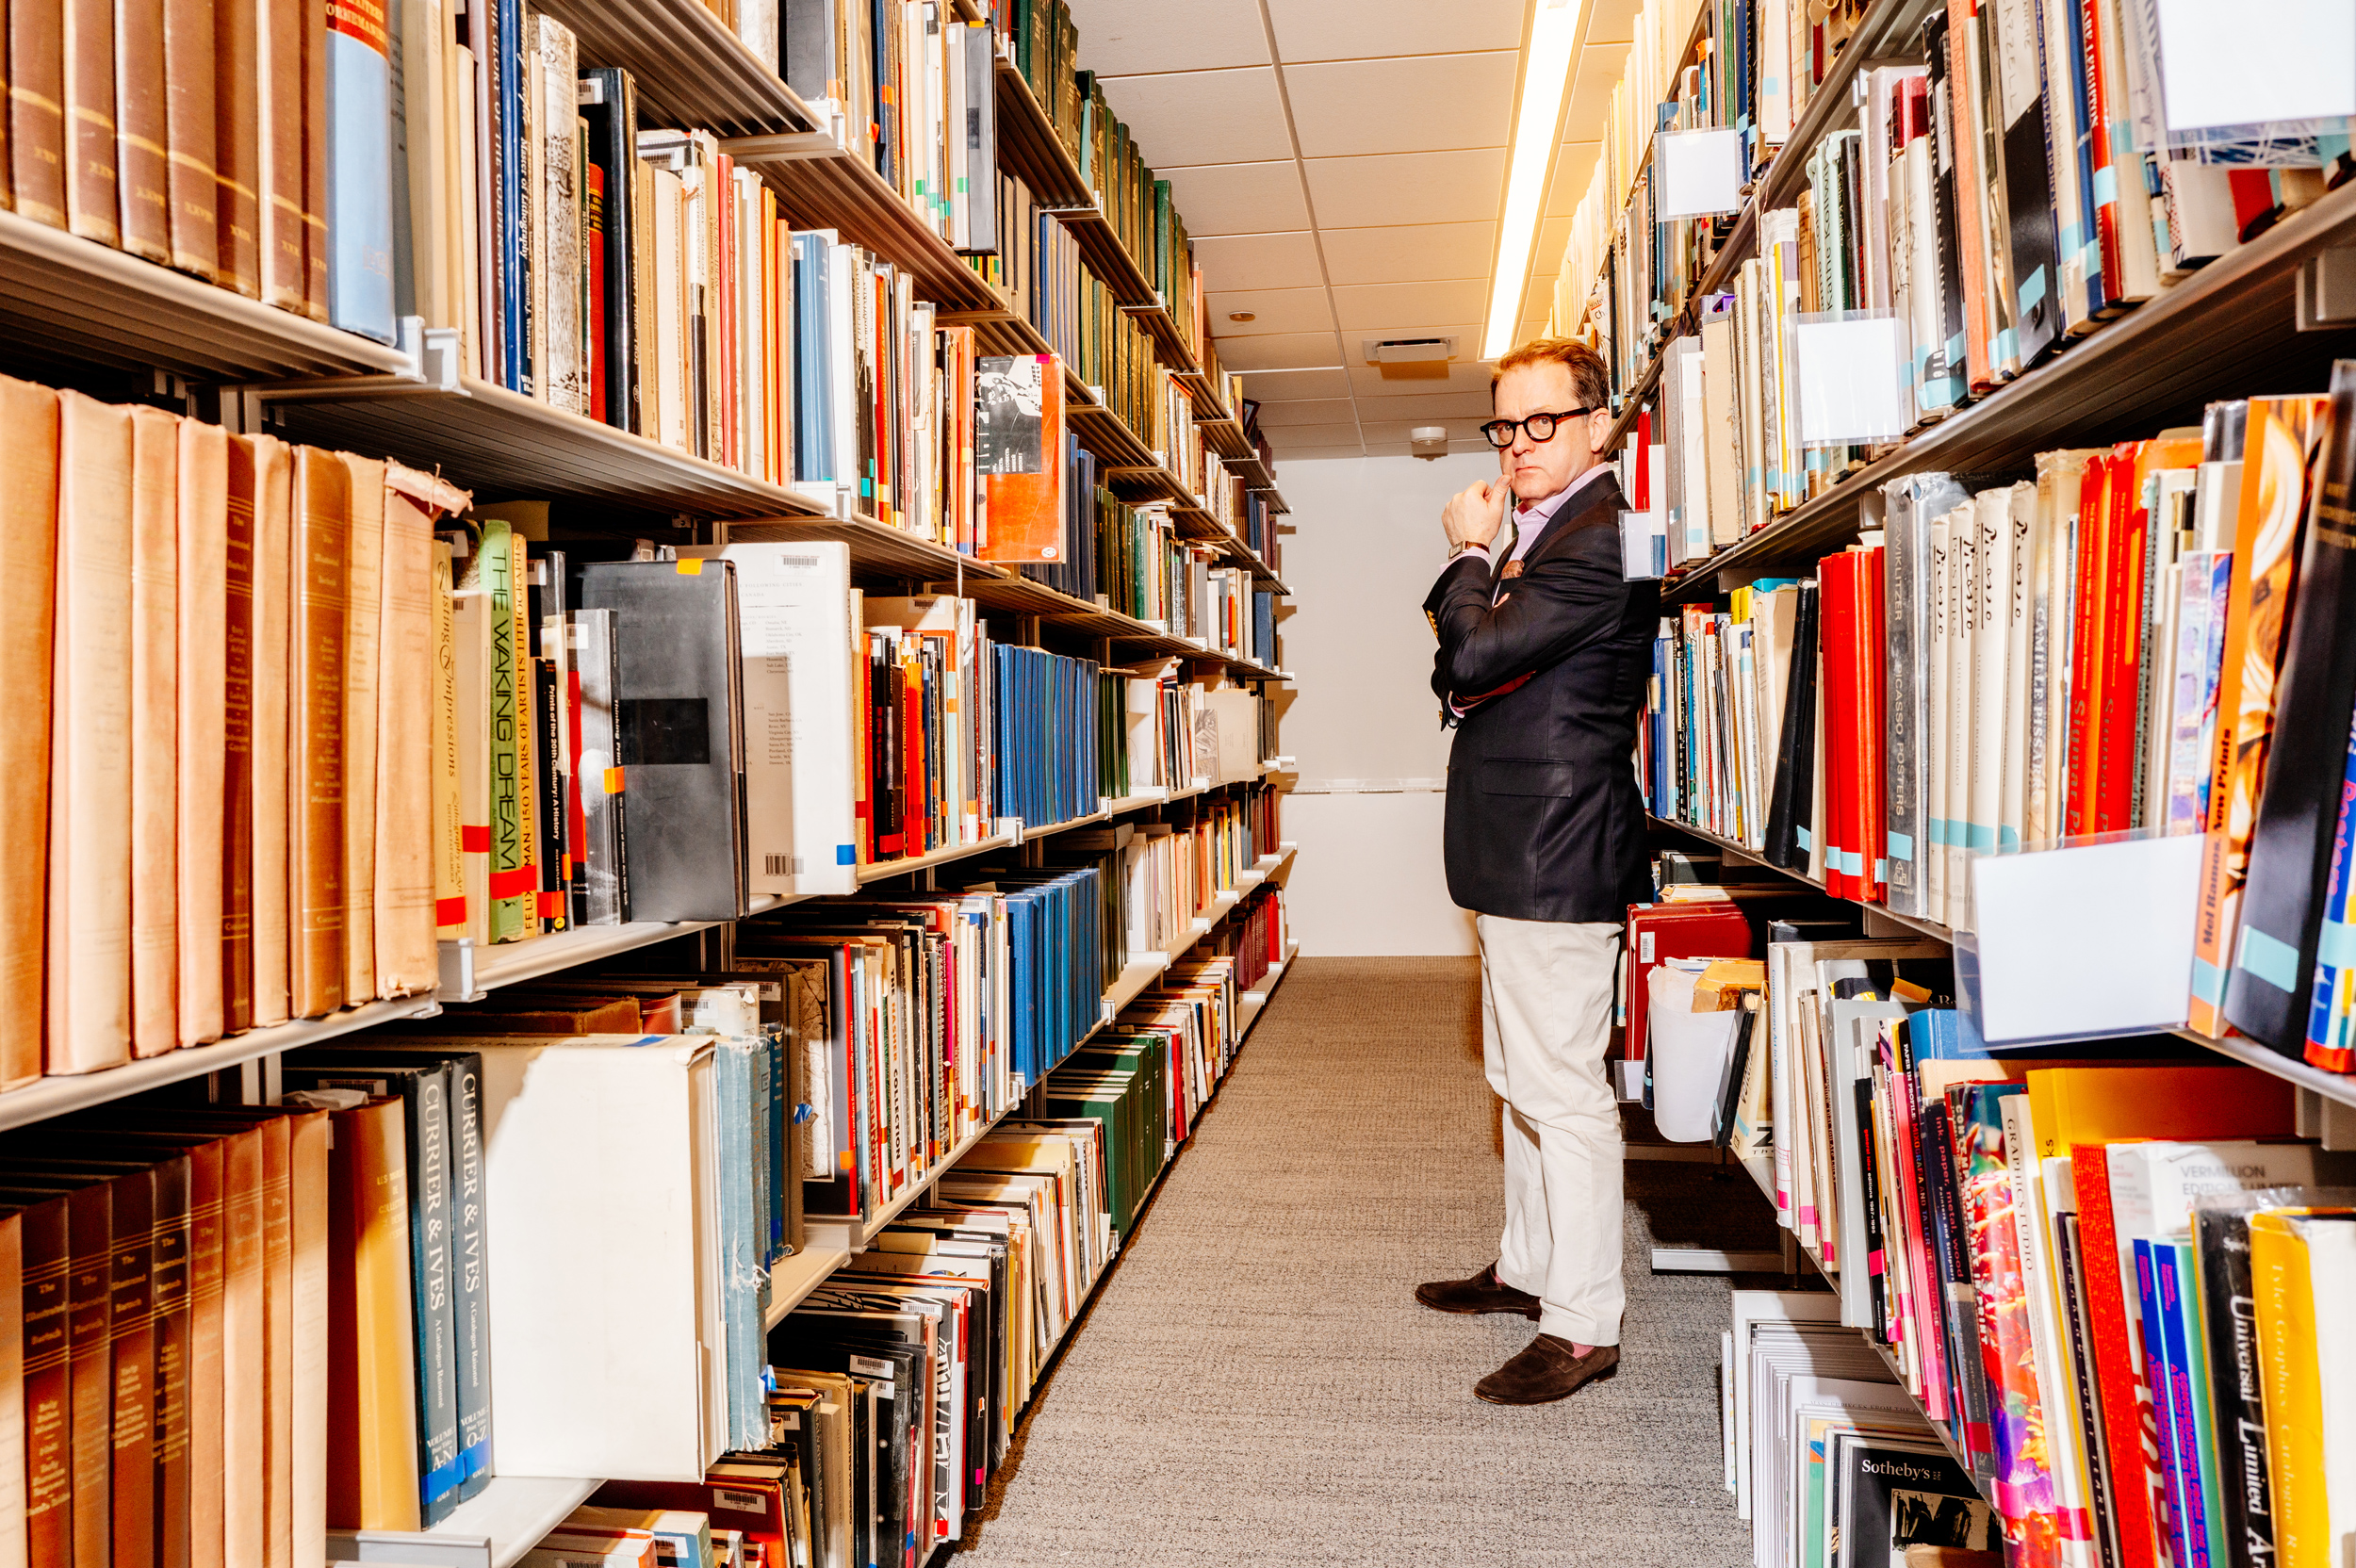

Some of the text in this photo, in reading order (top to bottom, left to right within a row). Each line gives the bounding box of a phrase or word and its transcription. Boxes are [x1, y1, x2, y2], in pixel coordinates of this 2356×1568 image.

[492, 34, 501, 92] GLORY
[1953, 35, 1964, 125] LARSSON
[2085, 44, 2099, 129] LEIGHTON
[494, 102, 503, 125] OF
[496, 132, 504, 168] THE
[2041, 88, 2057, 211] BLANCHE LAZZELL
[519, 137, 531, 259] Master of Lithography
[523, 270, 532, 304] Kenneth
[1936, 548, 1947, 634] Picasso
[1984, 527, 1998, 621] Picasso
[2016, 519, 2028, 618] Picasso
[514, 542, 526, 650] LITHOGRAPHS
[437, 562, 456, 777] Lasting Impressions
[517, 653, 528, 716] ARTISTS'
[492, 548, 516, 871] THE WAKING DREAM
[550, 711, 556, 722] of
[1895, 663, 1904, 735] PICASSO
[2032, 606, 2045, 807] CAMILLE PISSARRO
[519, 720, 529, 740] OF
[2069, 698, 2086, 802] Sigmar
[520, 743, 530, 792] YEARS
[1896, 742, 1905, 816] POSTERS
[522, 832, 532, 866] MAN
[2201, 728, 2231, 945] Mel Ramos. New Prints
[1774, 1049, 1778, 1057] in
[1904, 1043, 1912, 1070] PAPER
[1906, 1070, 1913, 1082] IN
[1907, 1083, 1917, 1121] PROFILE:
[1935, 1116, 1945, 1141] ink,
[1864, 1128, 1873, 1156] general
[1911, 1122, 1924, 1184] MIXOGRAFIA
[1938, 1145, 1950, 1187] paper,
[1955, 1103, 1977, 1232] CONTEMPORARY
[424, 1083, 446, 1312] CURRIER & IVES
[461, 1072, 480, 1293] CURRIER & IVES
[2180, 1165, 2266, 1178] VERMILLION
[1939, 1186, 1947, 1220] Painters
[1946, 1241, 1955, 1282] Sculptors
[1946, 1191, 1957, 1233] metal,
[1926, 1248, 1934, 1263] DE
[1952, 1238, 1965, 1278] wood
[1972, 1235, 1980, 1267] ART
[1974, 1273, 1983, 1290] IN
[2268, 1265, 2285, 1311] Tyler
[469, 1300, 480, 1388] A Catalogue Raisonné
[1977, 1296, 1988, 1346] PRINT
[434, 1319, 445, 1410] A Catalogue Raisonné
[461, 1408, 486, 1428] VOLUME
[2156, 1360, 2176, 1463] CONVERSATIONS
[2172, 1375, 2184, 1414] Master
[2230, 1295, 2269, 1516] Universal Limited
[427, 1427, 454, 1448] VOLUME
[433, 1446, 453, 1472] A-N
[466, 1425, 487, 1448] O-Z
[2179, 1371, 2207, 1549] CONVERSATIONS FROM THE
[1861, 1459, 1931, 1481] Sotheby's
[2091, 1454, 2105, 1517] YEARS
